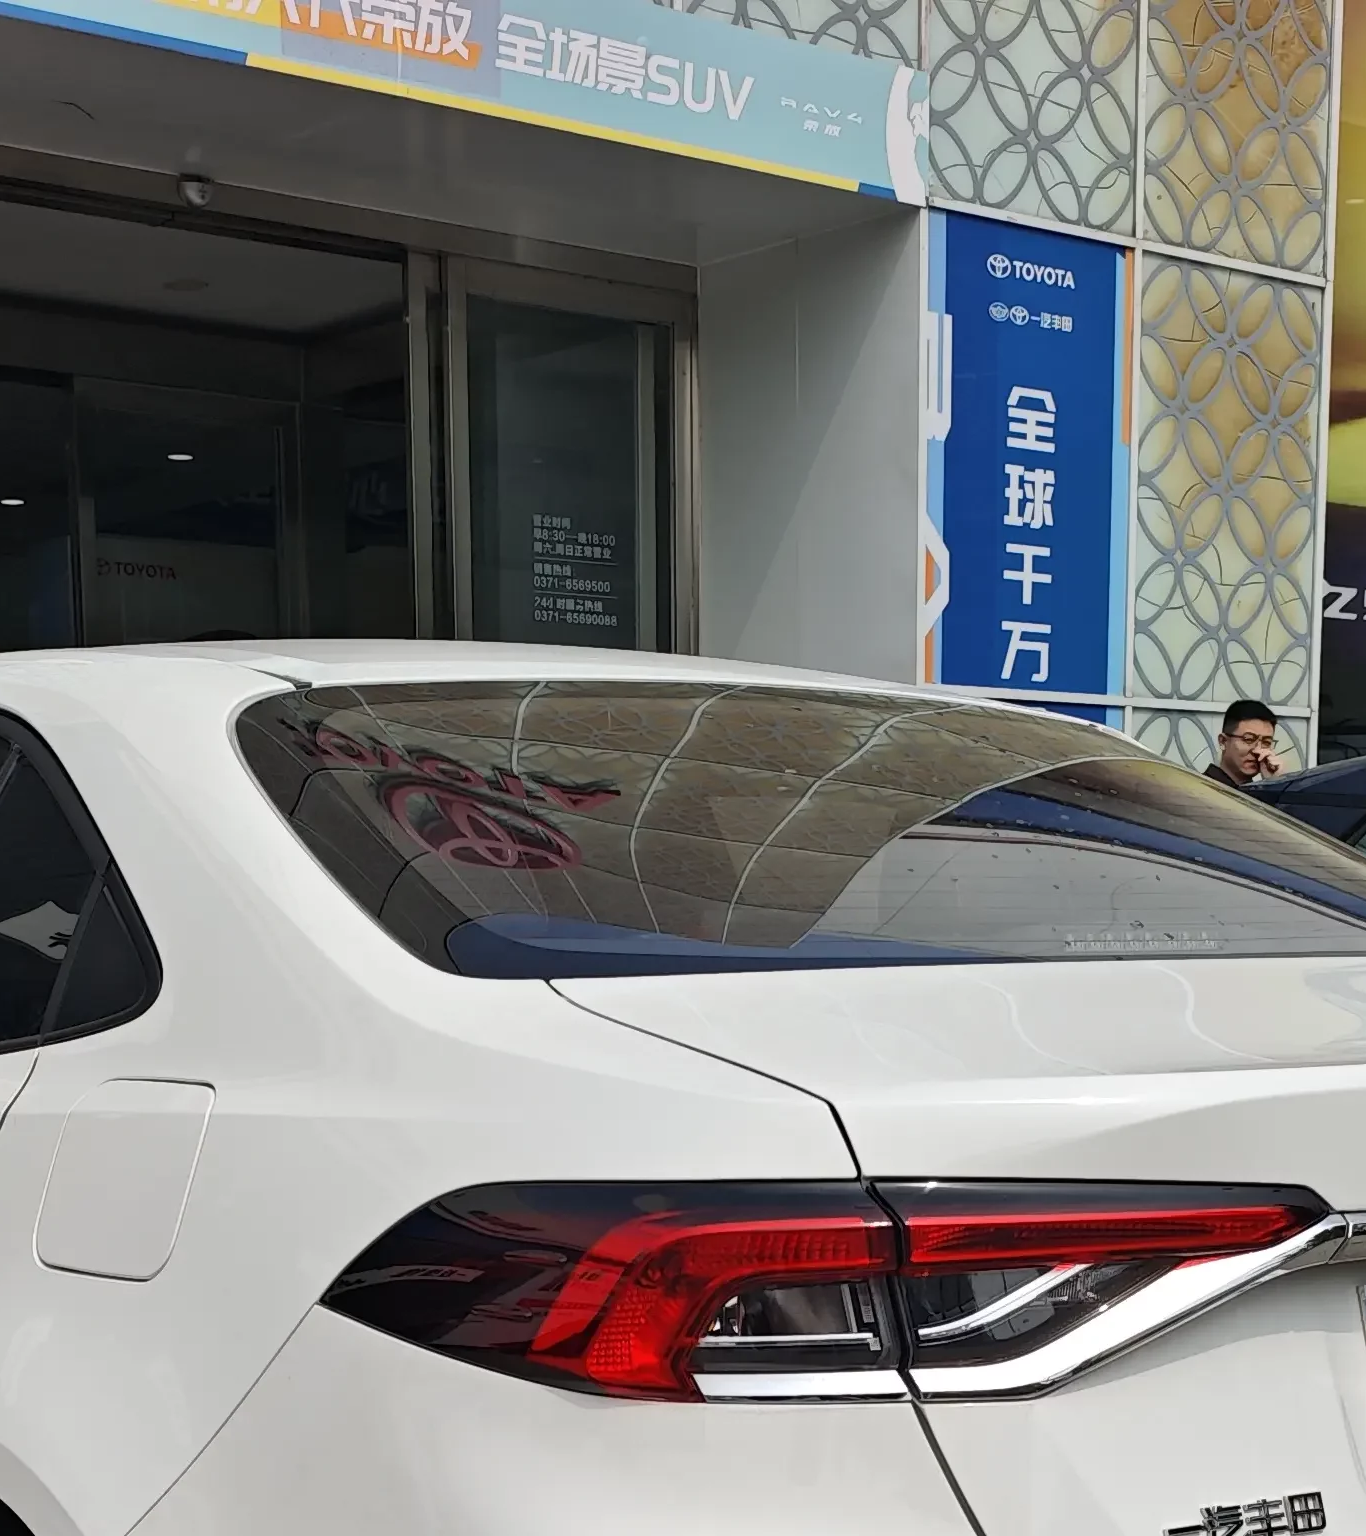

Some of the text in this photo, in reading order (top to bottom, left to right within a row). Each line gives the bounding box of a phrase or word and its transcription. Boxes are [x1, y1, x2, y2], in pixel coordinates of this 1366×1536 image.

[495, 13, 755, 121] 全场景SUV
[780, 96, 863, 125] RAV4
[802, 119, 842, 138] 荣放
[1012, 260, 1075, 290] TOYOTA
[1030, 310, 1073, 333] 一汽丰田
